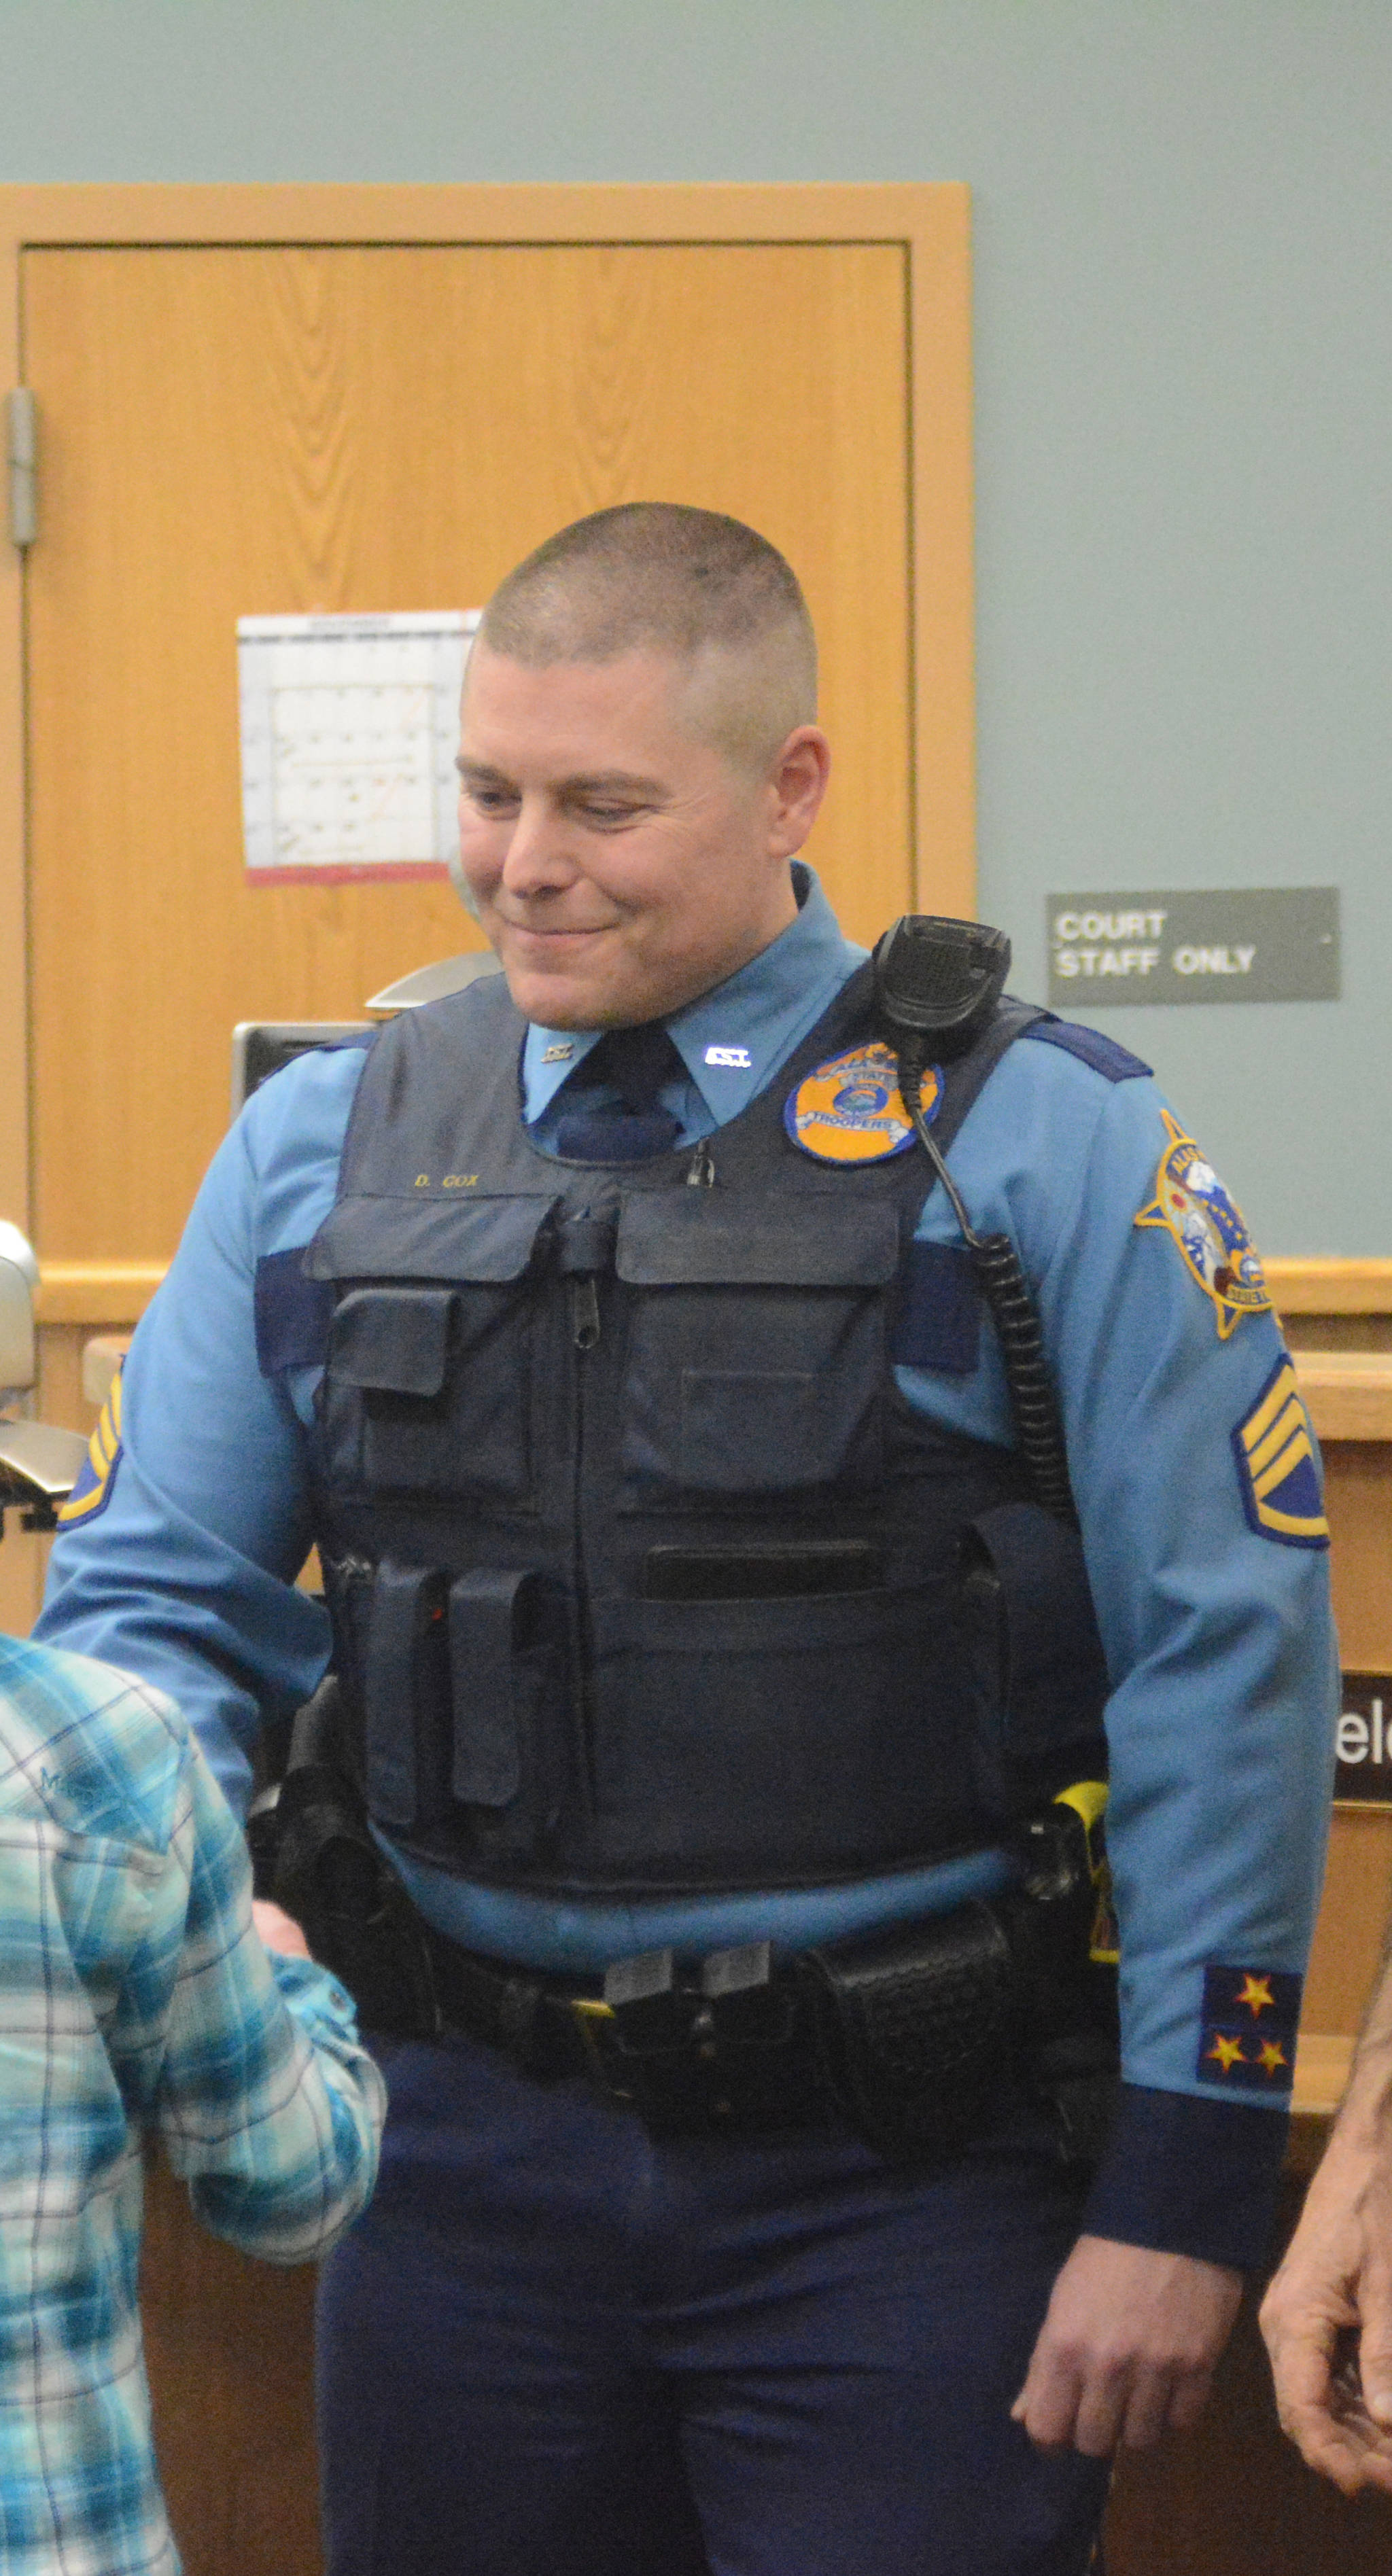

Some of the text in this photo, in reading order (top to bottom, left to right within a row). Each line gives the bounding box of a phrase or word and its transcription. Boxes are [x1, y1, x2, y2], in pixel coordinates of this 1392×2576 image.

[1057, 910, 1167, 940] COURT
[1056, 944, 1256, 977] STAFF ONLY
[814, 1112, 892, 1129] TROOPERS
[415, 1174, 479, 1188] D. COX
